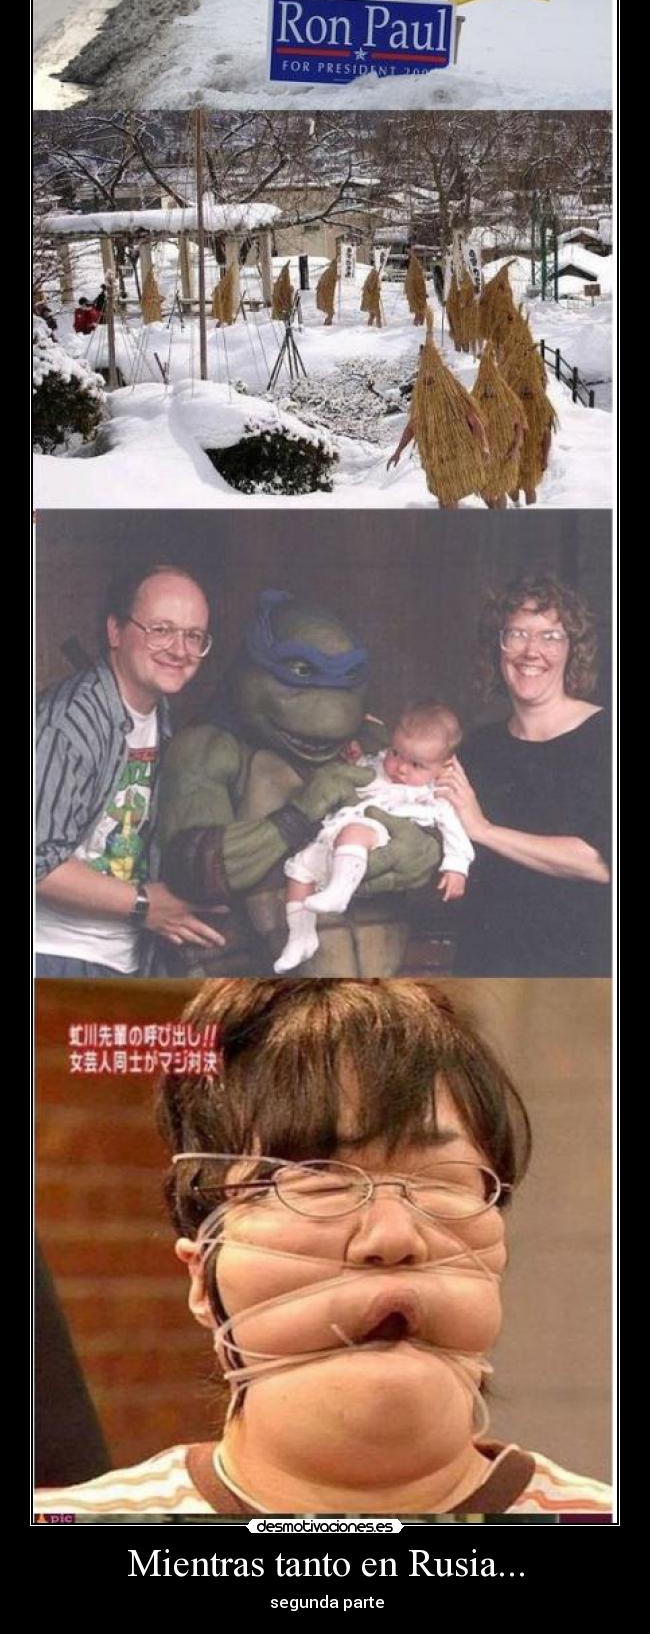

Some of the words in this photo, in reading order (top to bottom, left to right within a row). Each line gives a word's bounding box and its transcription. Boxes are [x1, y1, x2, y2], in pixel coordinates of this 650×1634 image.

[277, 0, 352, 45] Ron
[363, 5, 447, 52] Paul
[282, 60, 310, 72] FOR
[318, 62, 396, 75] PRESIDENT
